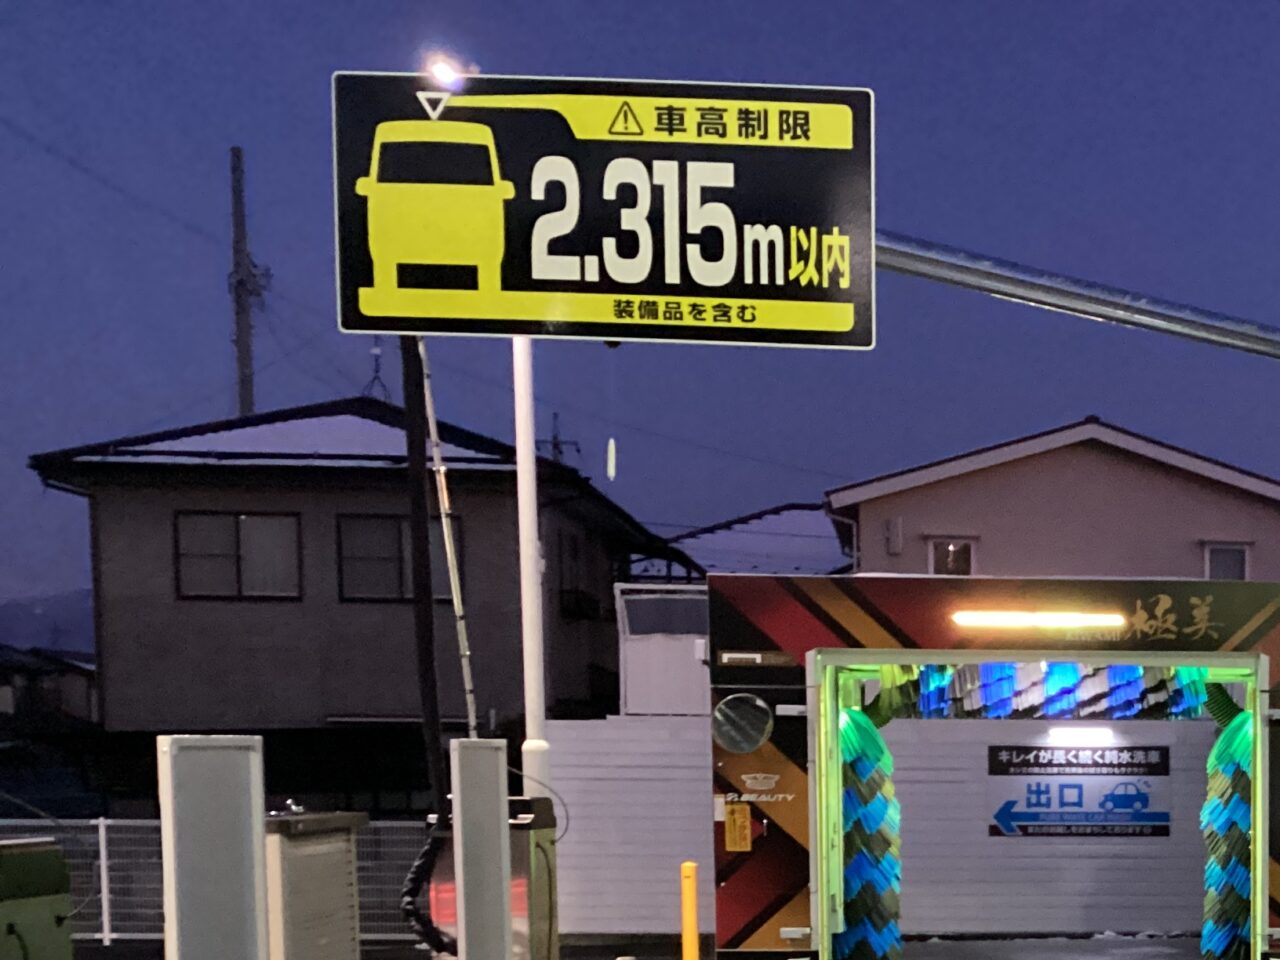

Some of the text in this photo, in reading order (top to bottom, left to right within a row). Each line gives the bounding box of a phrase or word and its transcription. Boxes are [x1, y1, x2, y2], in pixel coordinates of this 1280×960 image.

[654, 104, 812, 141] 車高制限
[613, 299, 757, 323] 装備品を含む
[1026, 782, 1083, 808] 出口
